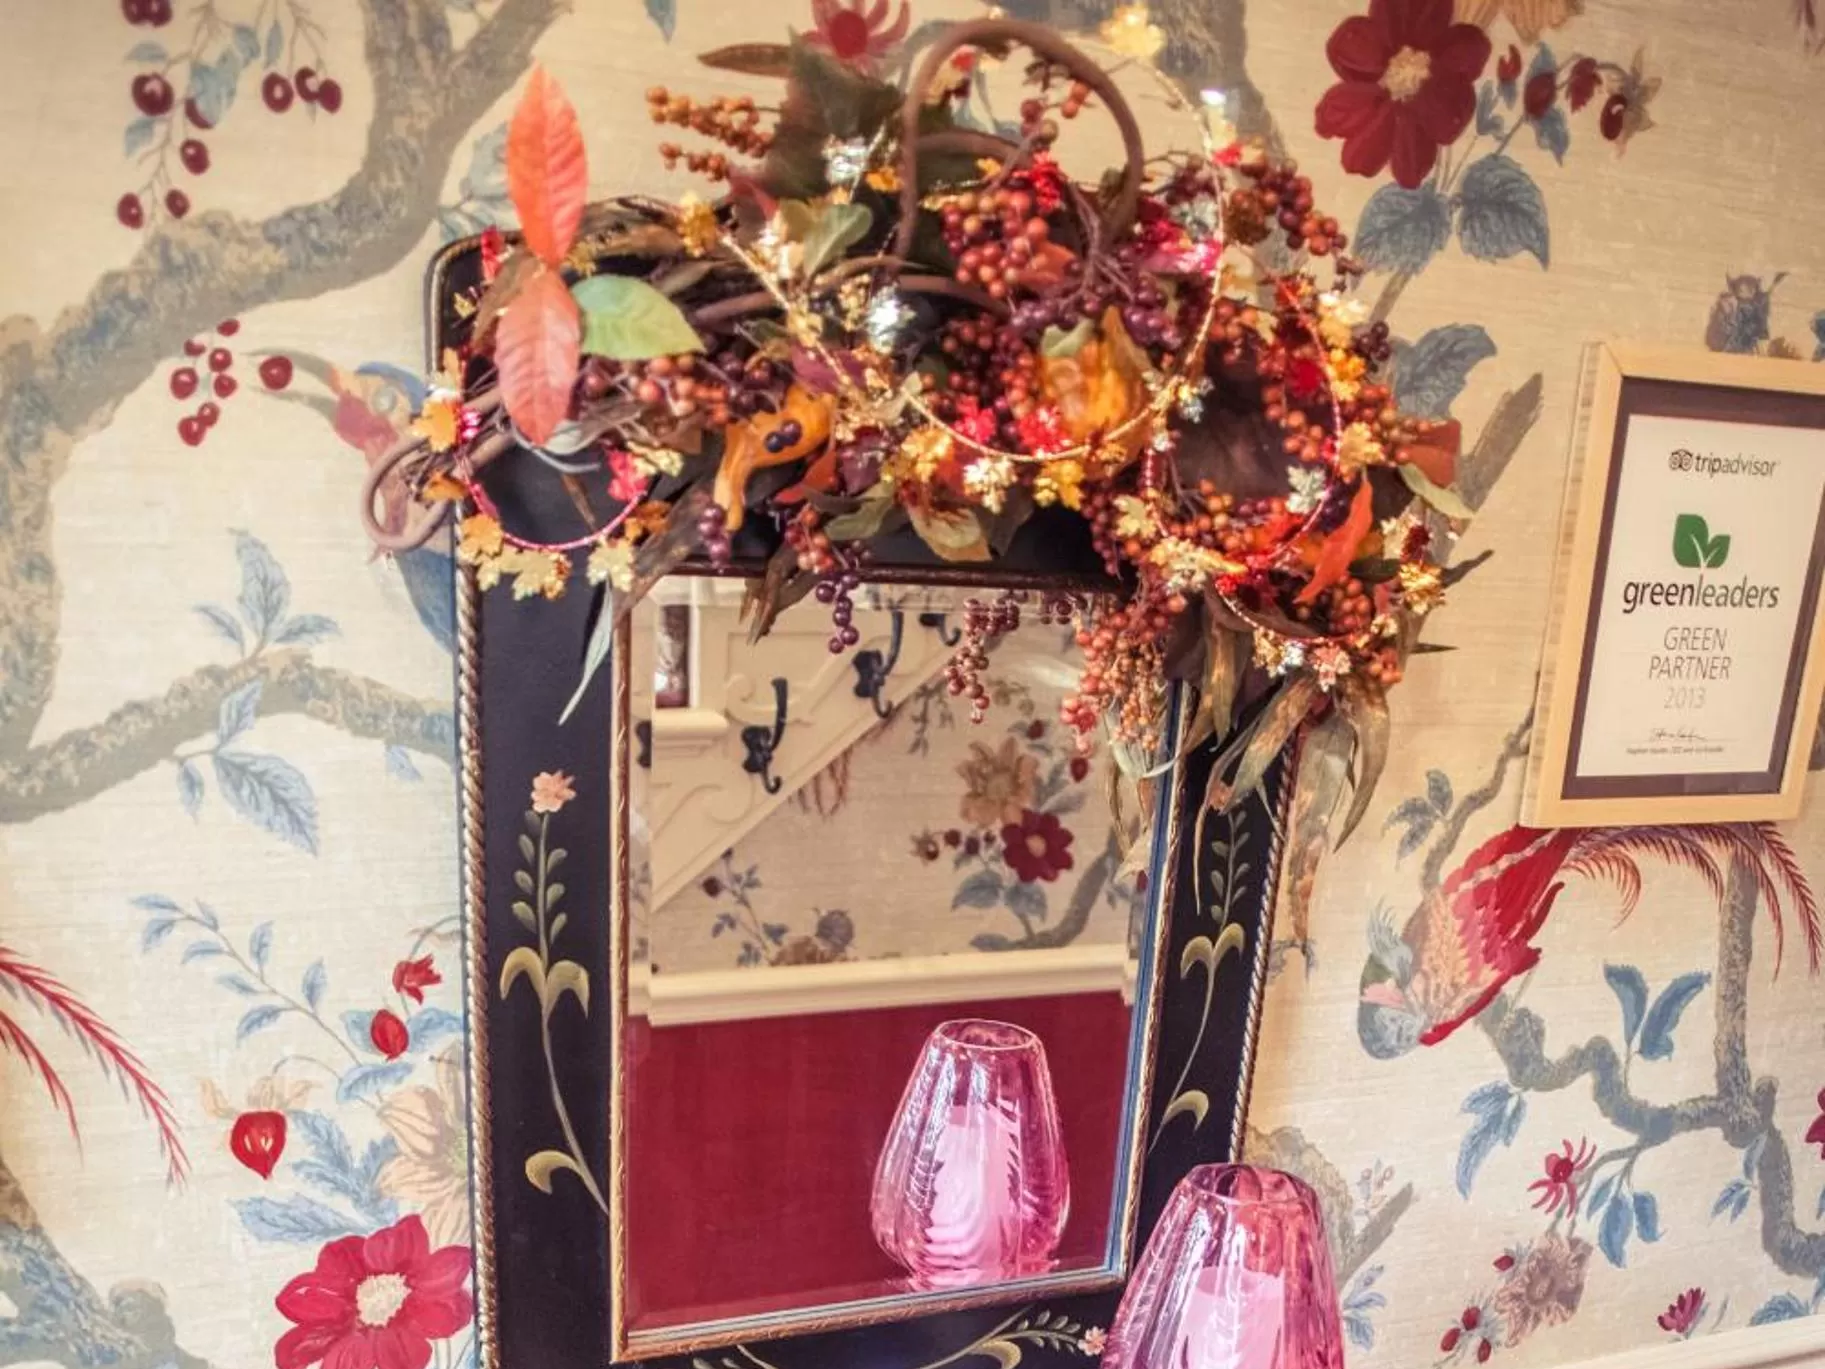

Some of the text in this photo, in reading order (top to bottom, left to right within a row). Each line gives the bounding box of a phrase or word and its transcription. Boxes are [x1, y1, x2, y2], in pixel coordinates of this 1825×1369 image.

[1694, 451, 1777, 477] tripadvisor
[1622, 575, 1780, 614] greenleaders
[1663, 626, 1729, 651] GREEN
[1648, 655, 1732, 680] PARTNER
[1664, 687, 1706, 709] 2013
